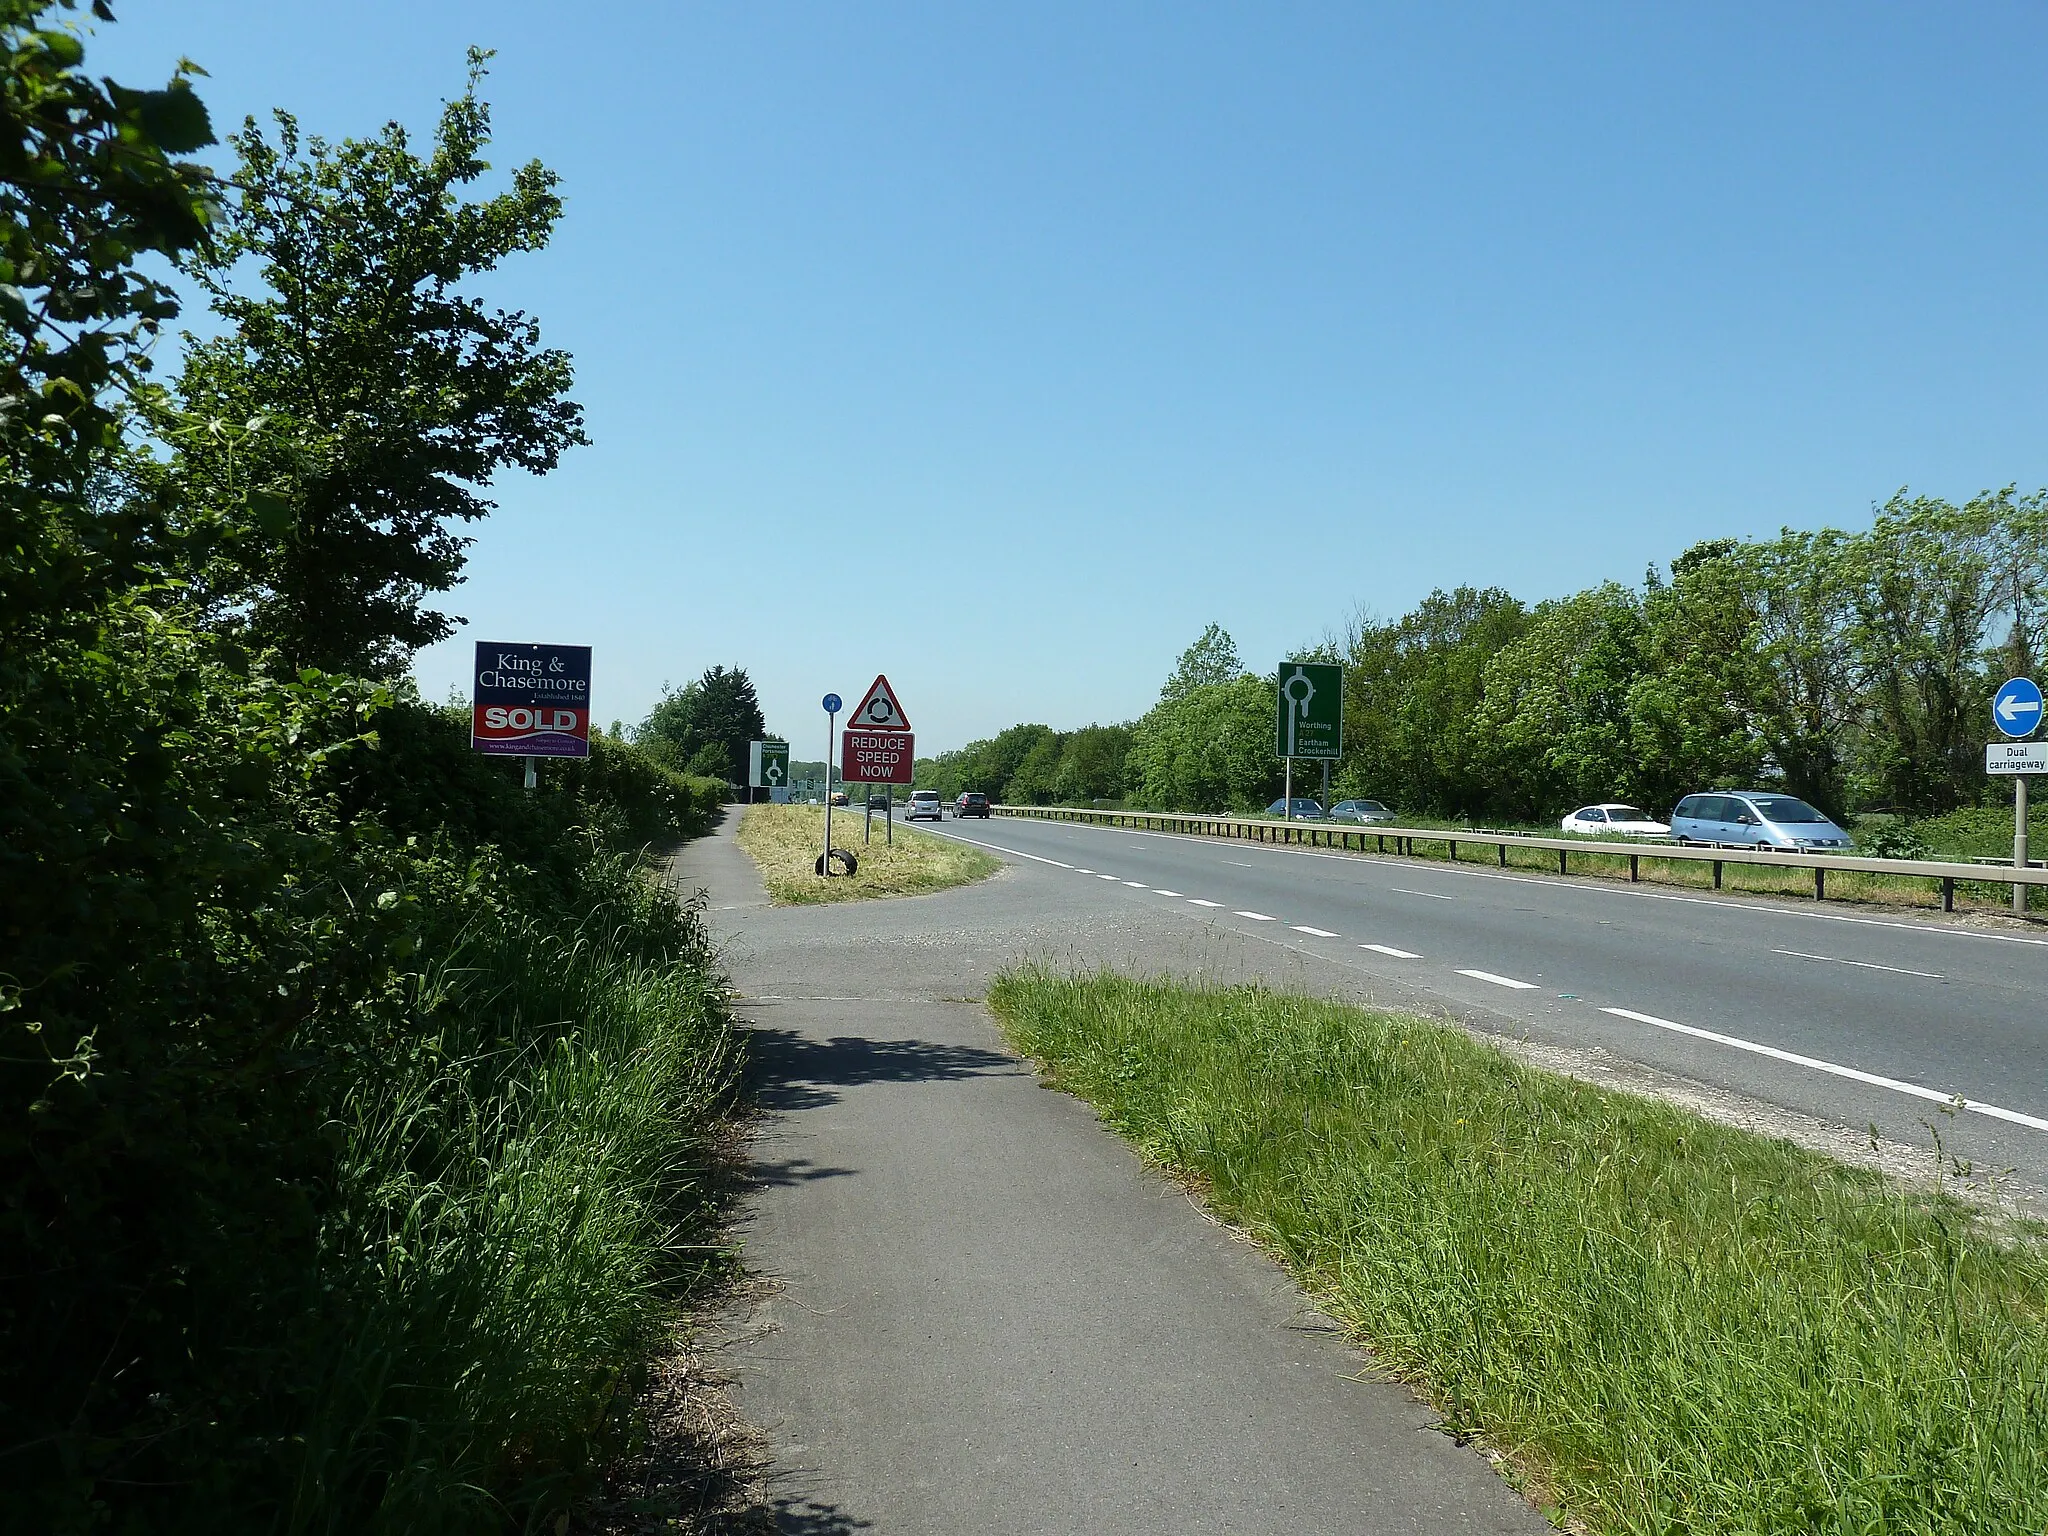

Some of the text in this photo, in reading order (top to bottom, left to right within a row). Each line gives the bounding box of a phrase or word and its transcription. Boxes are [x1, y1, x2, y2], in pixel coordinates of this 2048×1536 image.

[497, 653, 565, 676] King &
[479, 670, 586, 691] Chasemore
[485, 707, 577, 731] SOLD
[1299, 721, 1331, 730] Worthing
[851, 736, 905, 750] REDUCE
[856, 751, 900, 764] SPEED
[1299, 747, 1338, 755] Crockerhill
[2006, 747, 2028, 757] Dual
[1989, 759, 2045, 770] carriageway
[860, 765, 894, 778] NOW
